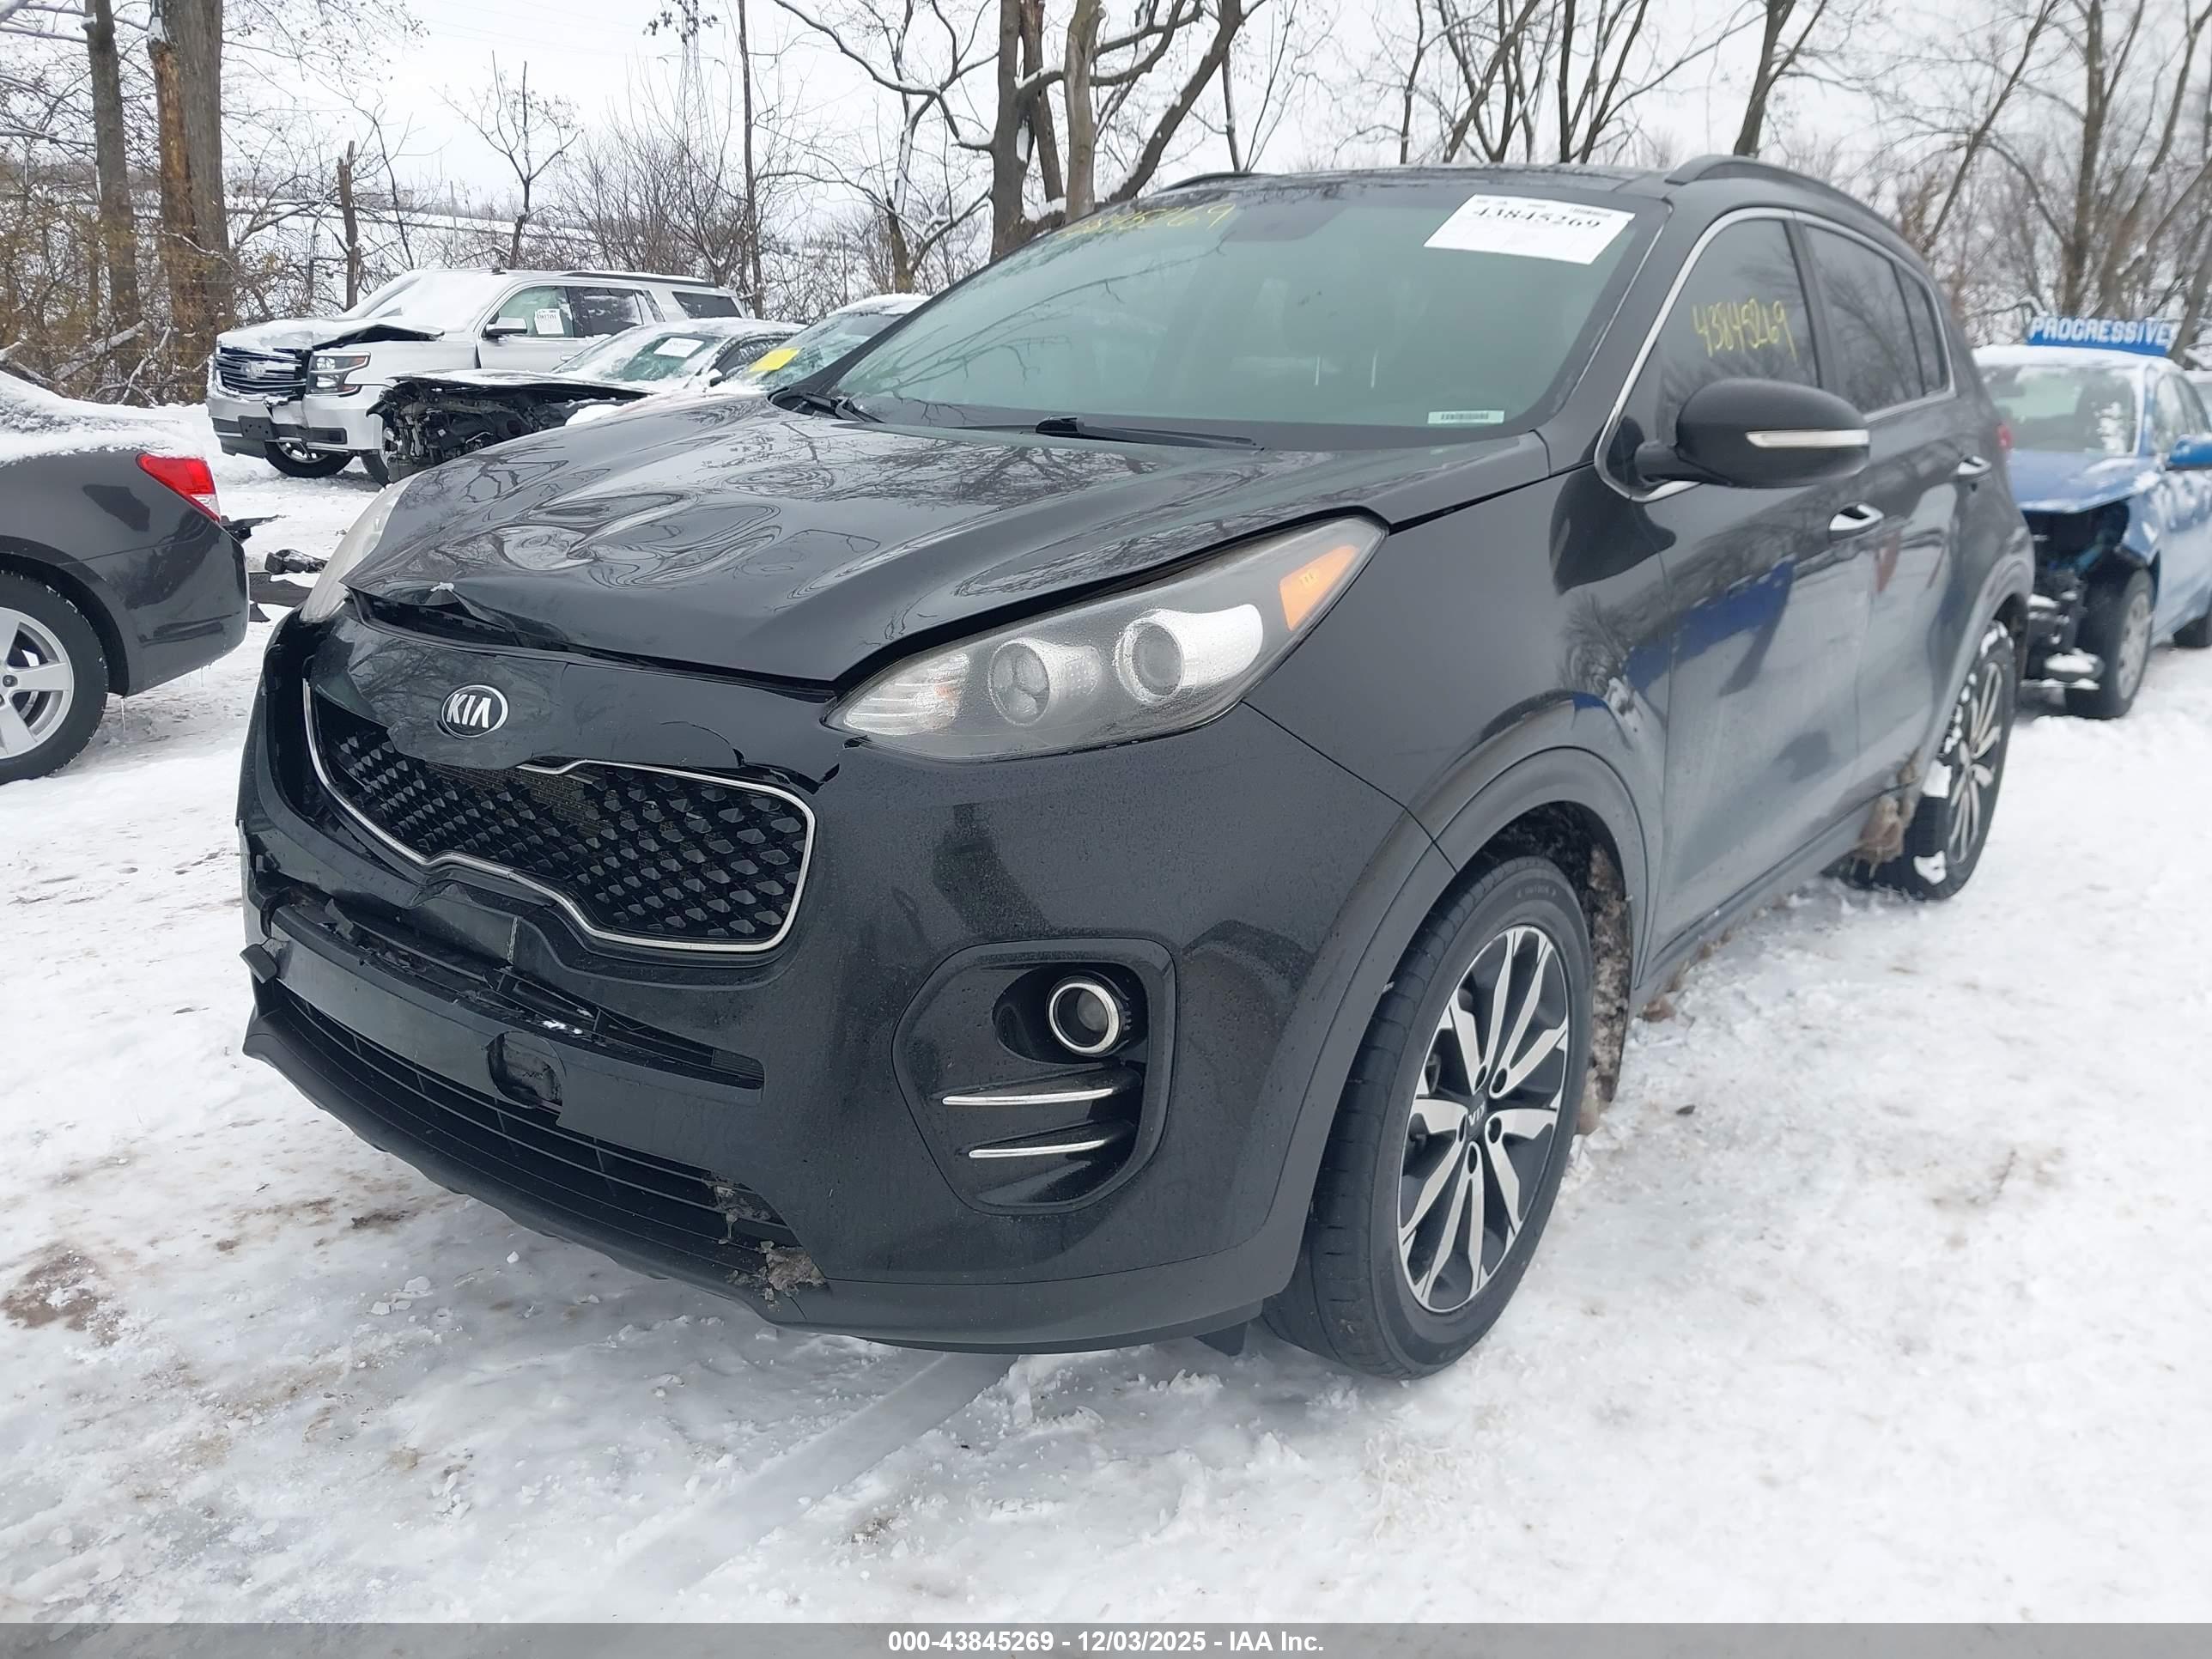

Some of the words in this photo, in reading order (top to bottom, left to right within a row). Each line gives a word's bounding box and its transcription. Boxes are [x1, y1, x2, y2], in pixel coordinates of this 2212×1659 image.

[1474, 206, 1601, 228] 43845269
[2028, 316, 2172, 345] PROGRESSIVE
[447, 693, 491, 729] KIA
